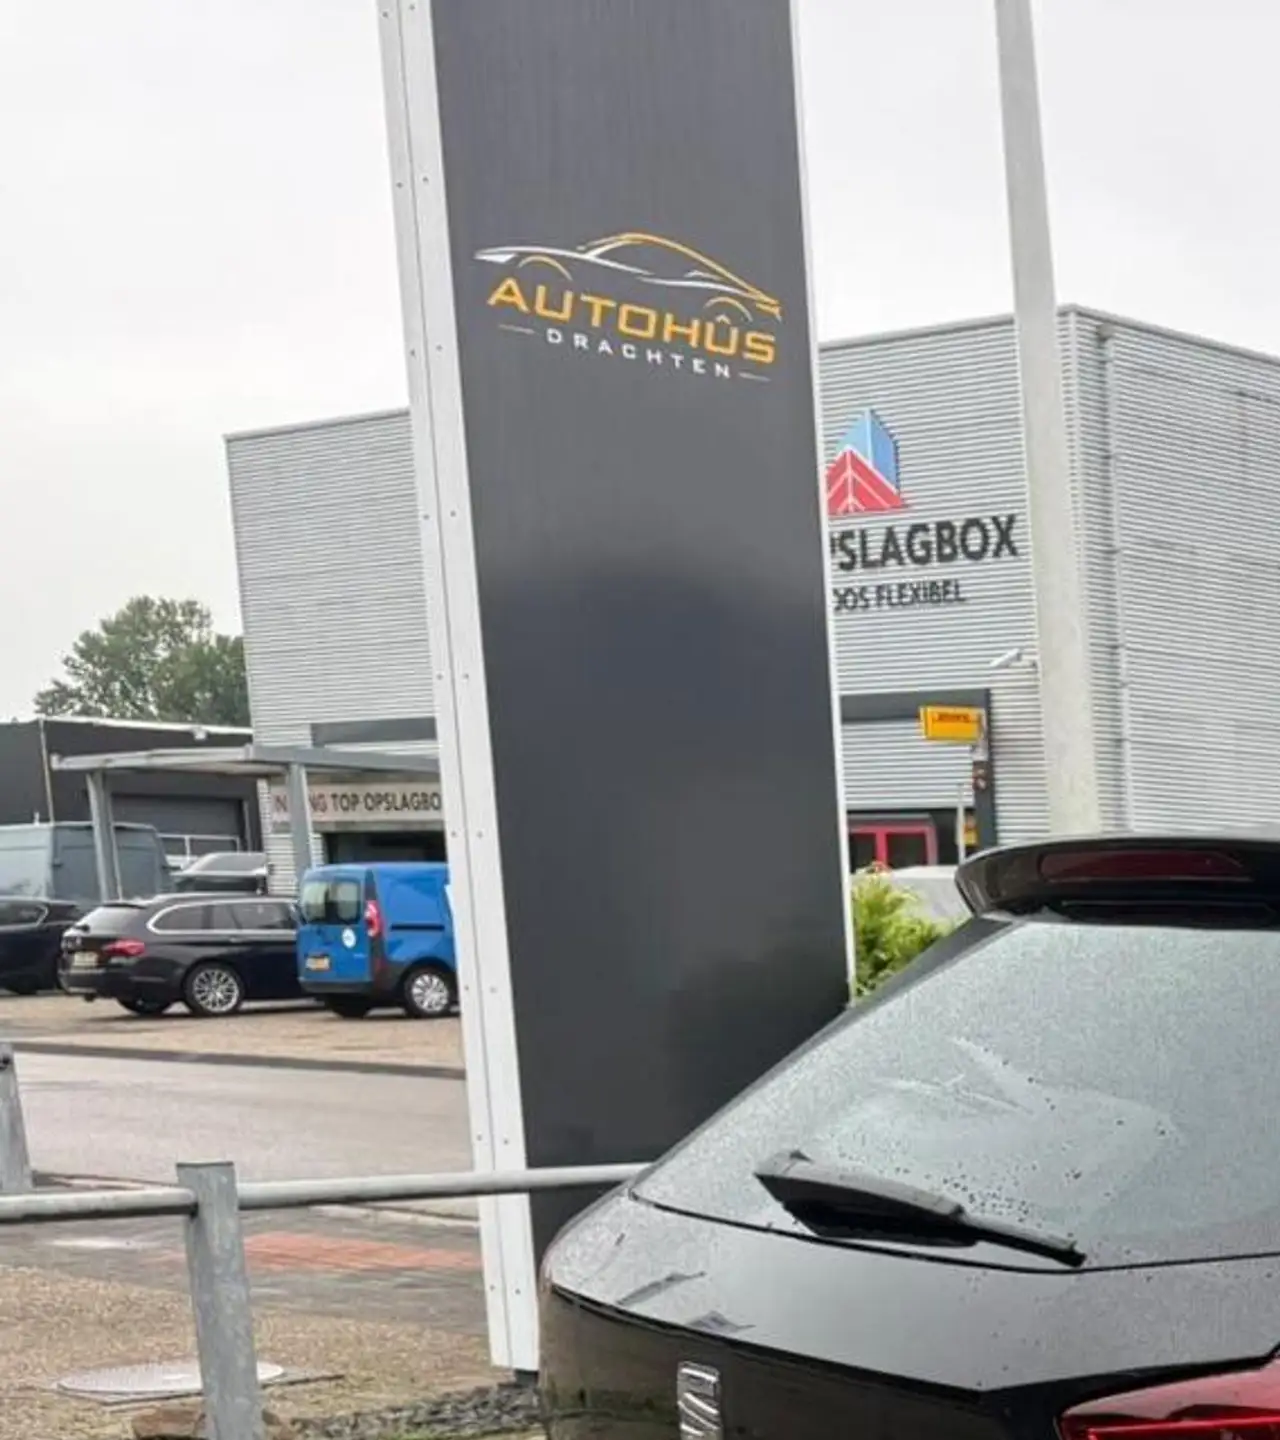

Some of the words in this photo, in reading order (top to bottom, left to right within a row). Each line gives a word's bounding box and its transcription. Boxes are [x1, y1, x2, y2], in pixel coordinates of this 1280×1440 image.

[487, 277, 777, 364] AUTOHÛS
[547, 328, 730, 378] DRACHTEN
[831, 514, 1018, 570] SLAGBOX
[876, 579, 968, 607] FLEXIBEL
[331, 793, 359, 812] TOP
[364, 792, 442, 812] OPSLAGBO
